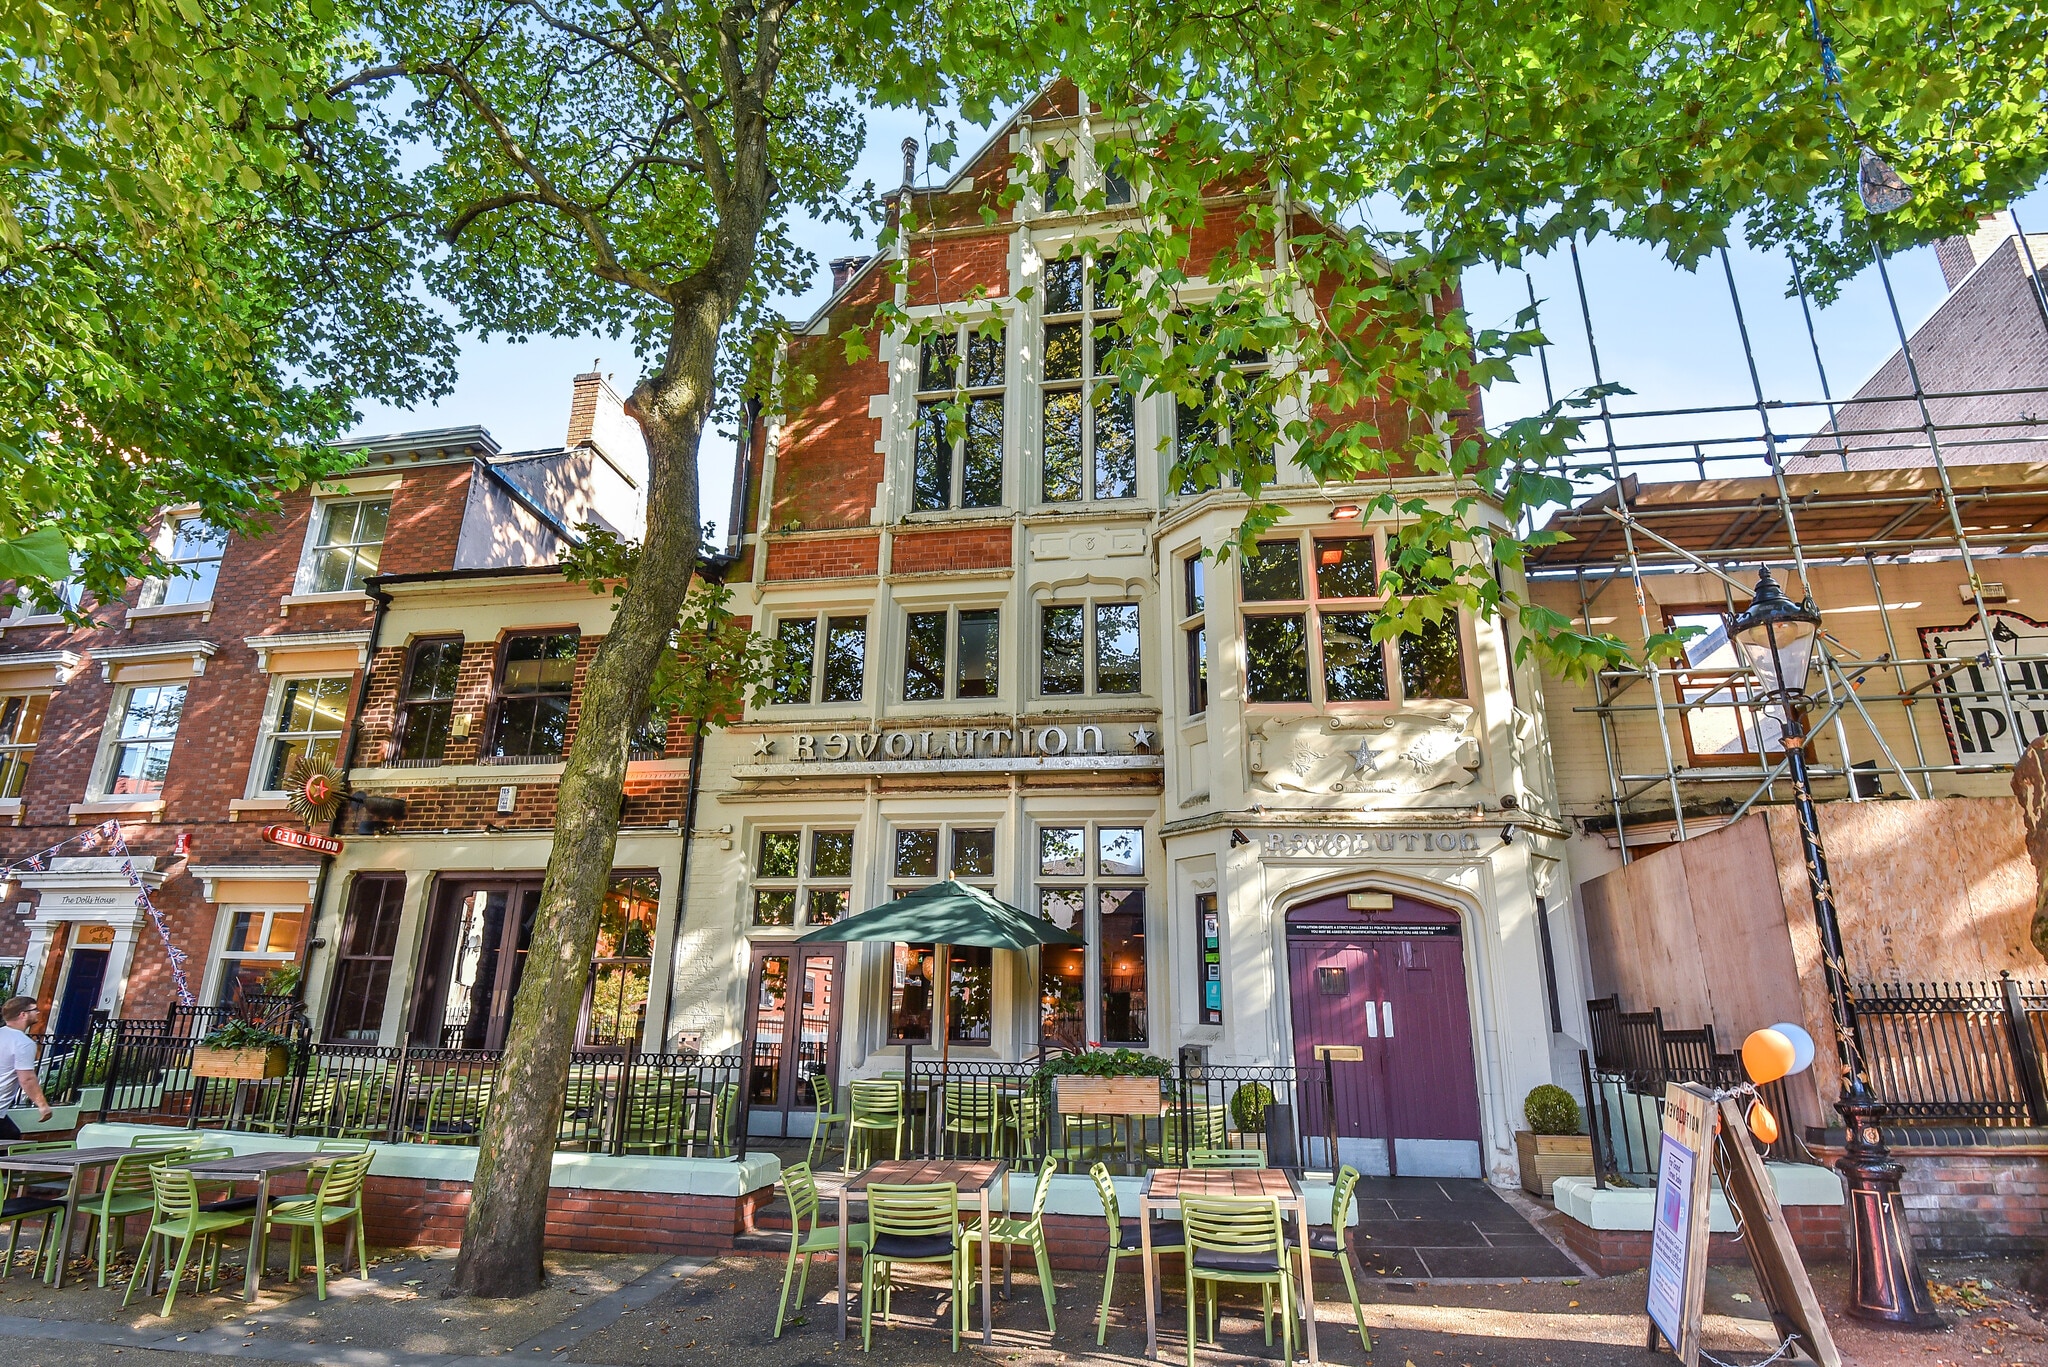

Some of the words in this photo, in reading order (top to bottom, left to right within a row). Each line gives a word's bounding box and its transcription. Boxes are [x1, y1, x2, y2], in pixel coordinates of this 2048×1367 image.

[1967, 707, 2048, 753] PU
[790, 724, 1107, 762] REVOLUTION
[275, 830, 339, 852] REVOLUTION
[1267, 832, 1480, 852] REVOLUTION
[61, 896, 74, 904] The
[94, 896, 116, 904] House
[1882, 1202, 1889, 1213] 7
